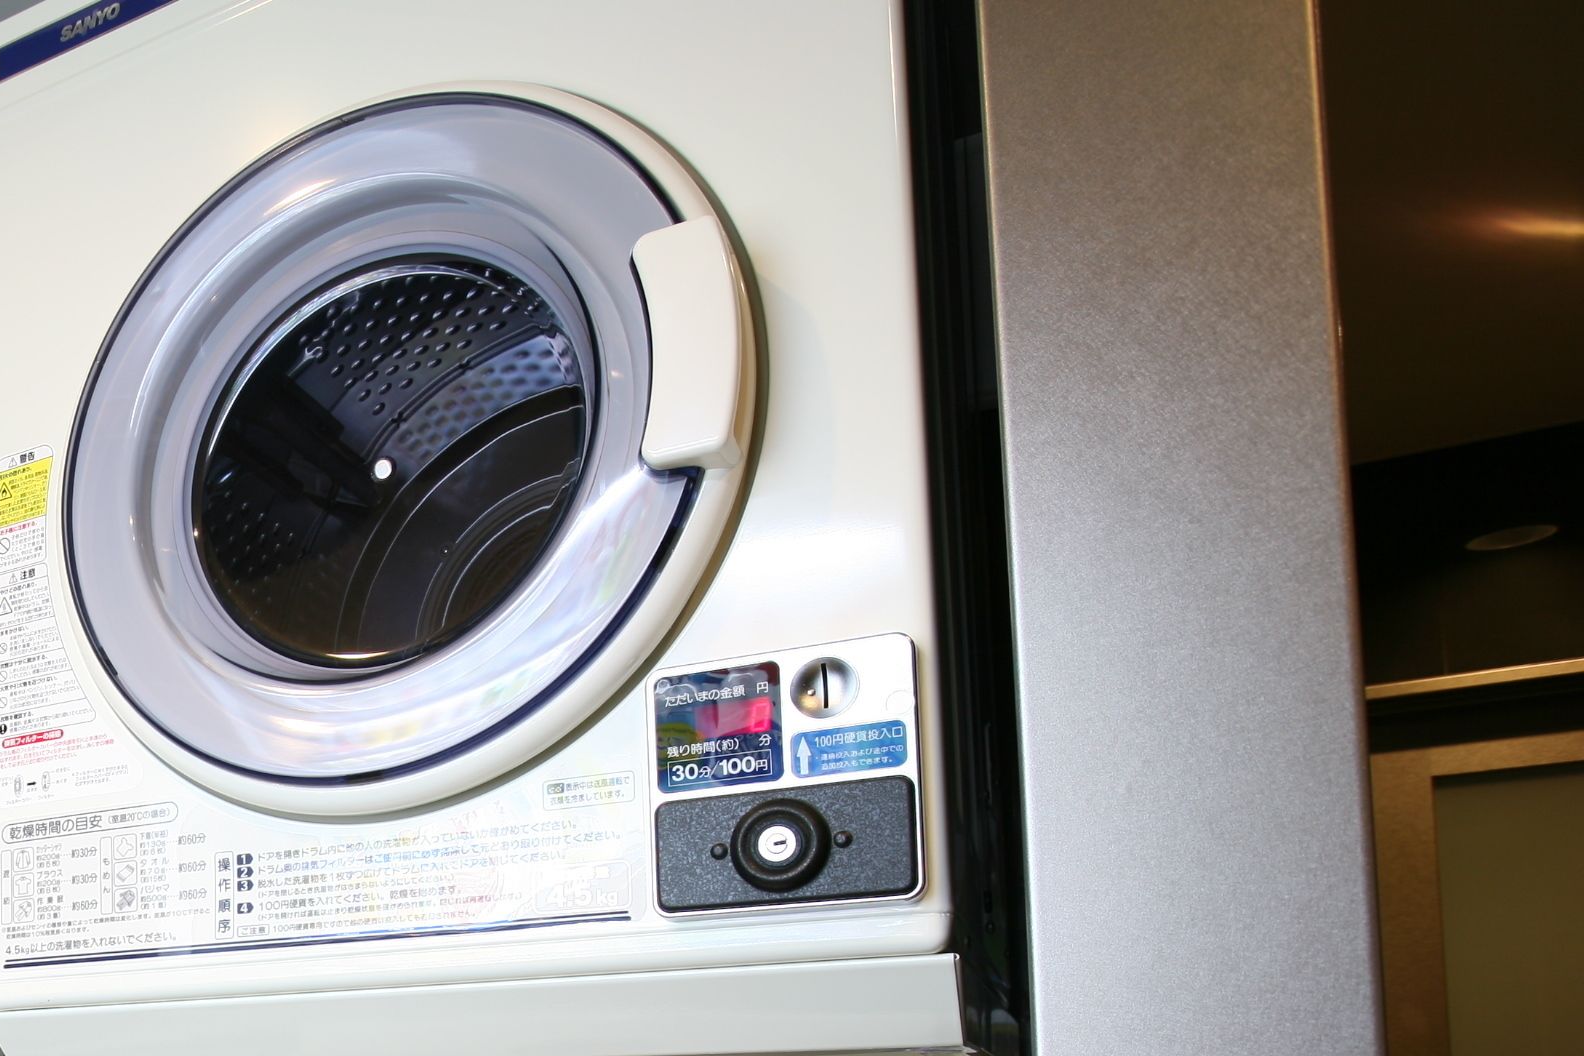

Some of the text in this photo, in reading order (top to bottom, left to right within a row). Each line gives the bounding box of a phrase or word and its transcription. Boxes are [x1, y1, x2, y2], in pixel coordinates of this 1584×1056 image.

[60, 2, 120, 42] SANYO
[665, 681, 769, 707] ただいまの金額 円
[666, 734, 772, 758] 残り時間(約) 分
[814, 726, 904, 747] 100円硬貨投入口
[671, 757, 768, 782] 30分/100円
[9, 815, 103, 840] 乾燥時間の目安
[218, 857, 231, 934] 操作順序
